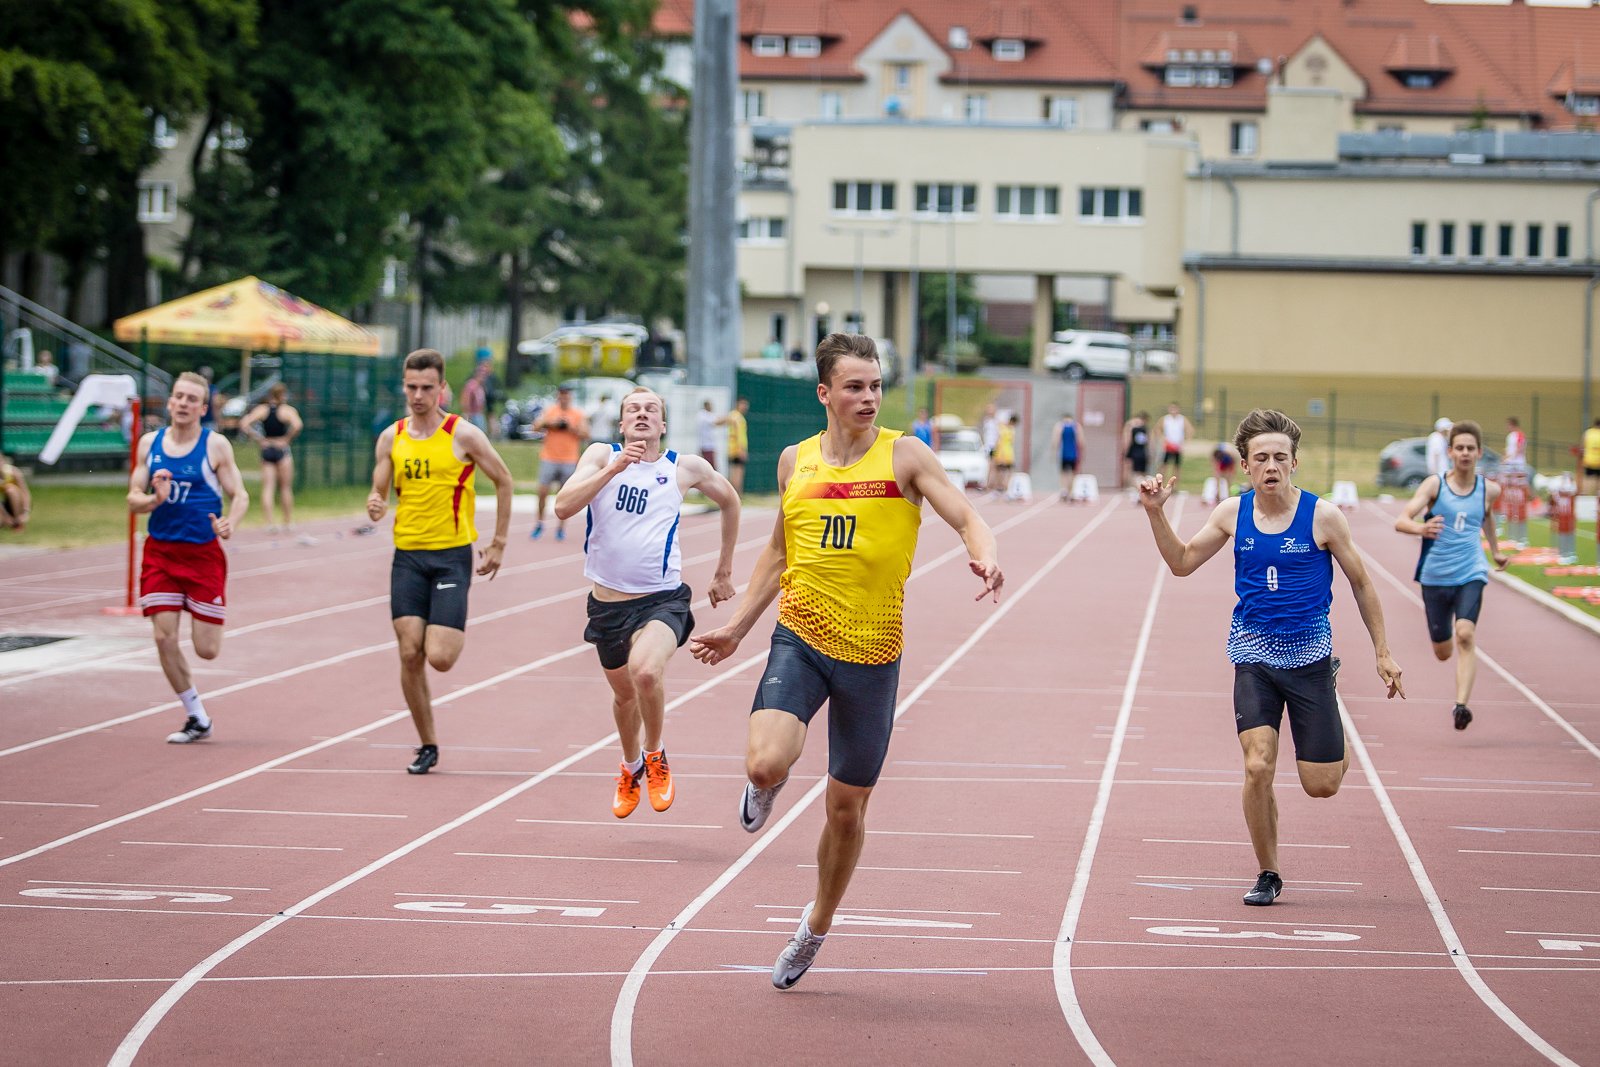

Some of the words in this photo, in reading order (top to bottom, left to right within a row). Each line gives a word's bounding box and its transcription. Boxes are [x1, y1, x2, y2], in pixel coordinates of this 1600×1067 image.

[404, 458, 430, 480] 521
[848, 489, 887, 497] WROCŁAW
[869, 481, 886, 489] MOS
[615, 484, 649, 515] 966
[820, 515, 857, 550] 707
[1454, 511, 1468, 532] 6
[1266, 565, 1279, 592] 9
